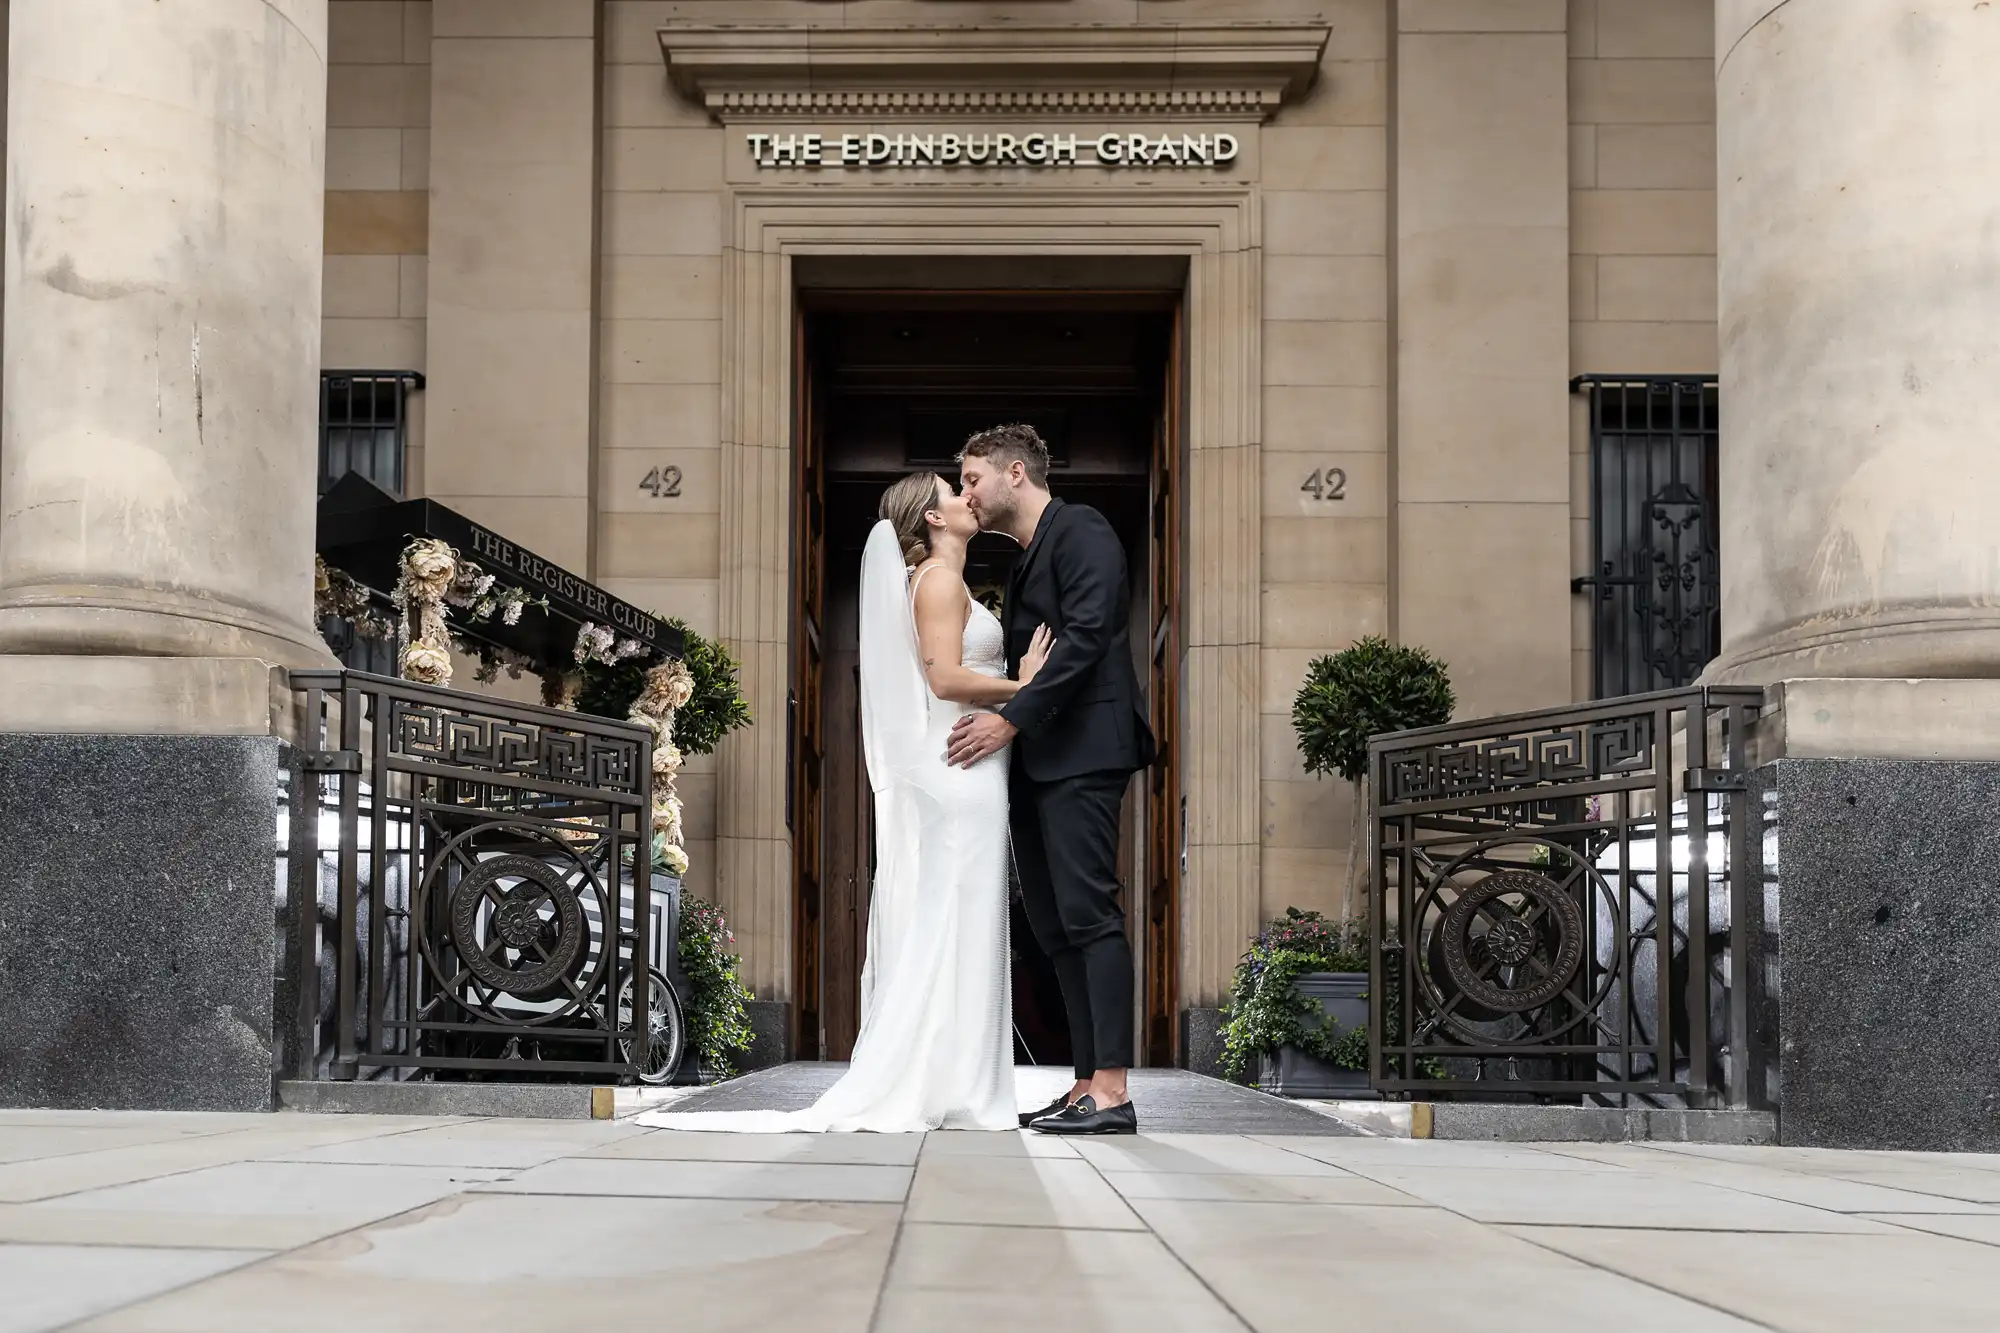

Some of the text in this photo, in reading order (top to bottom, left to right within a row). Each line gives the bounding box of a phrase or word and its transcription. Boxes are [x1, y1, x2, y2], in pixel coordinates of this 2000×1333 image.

[747, 133, 1239, 163] THE EDINBURGH GRAND
[639, 465, 682, 498] 42
[1301, 467, 1347, 500] 42
[470, 525, 656, 640] THE REGISTER CLUB
